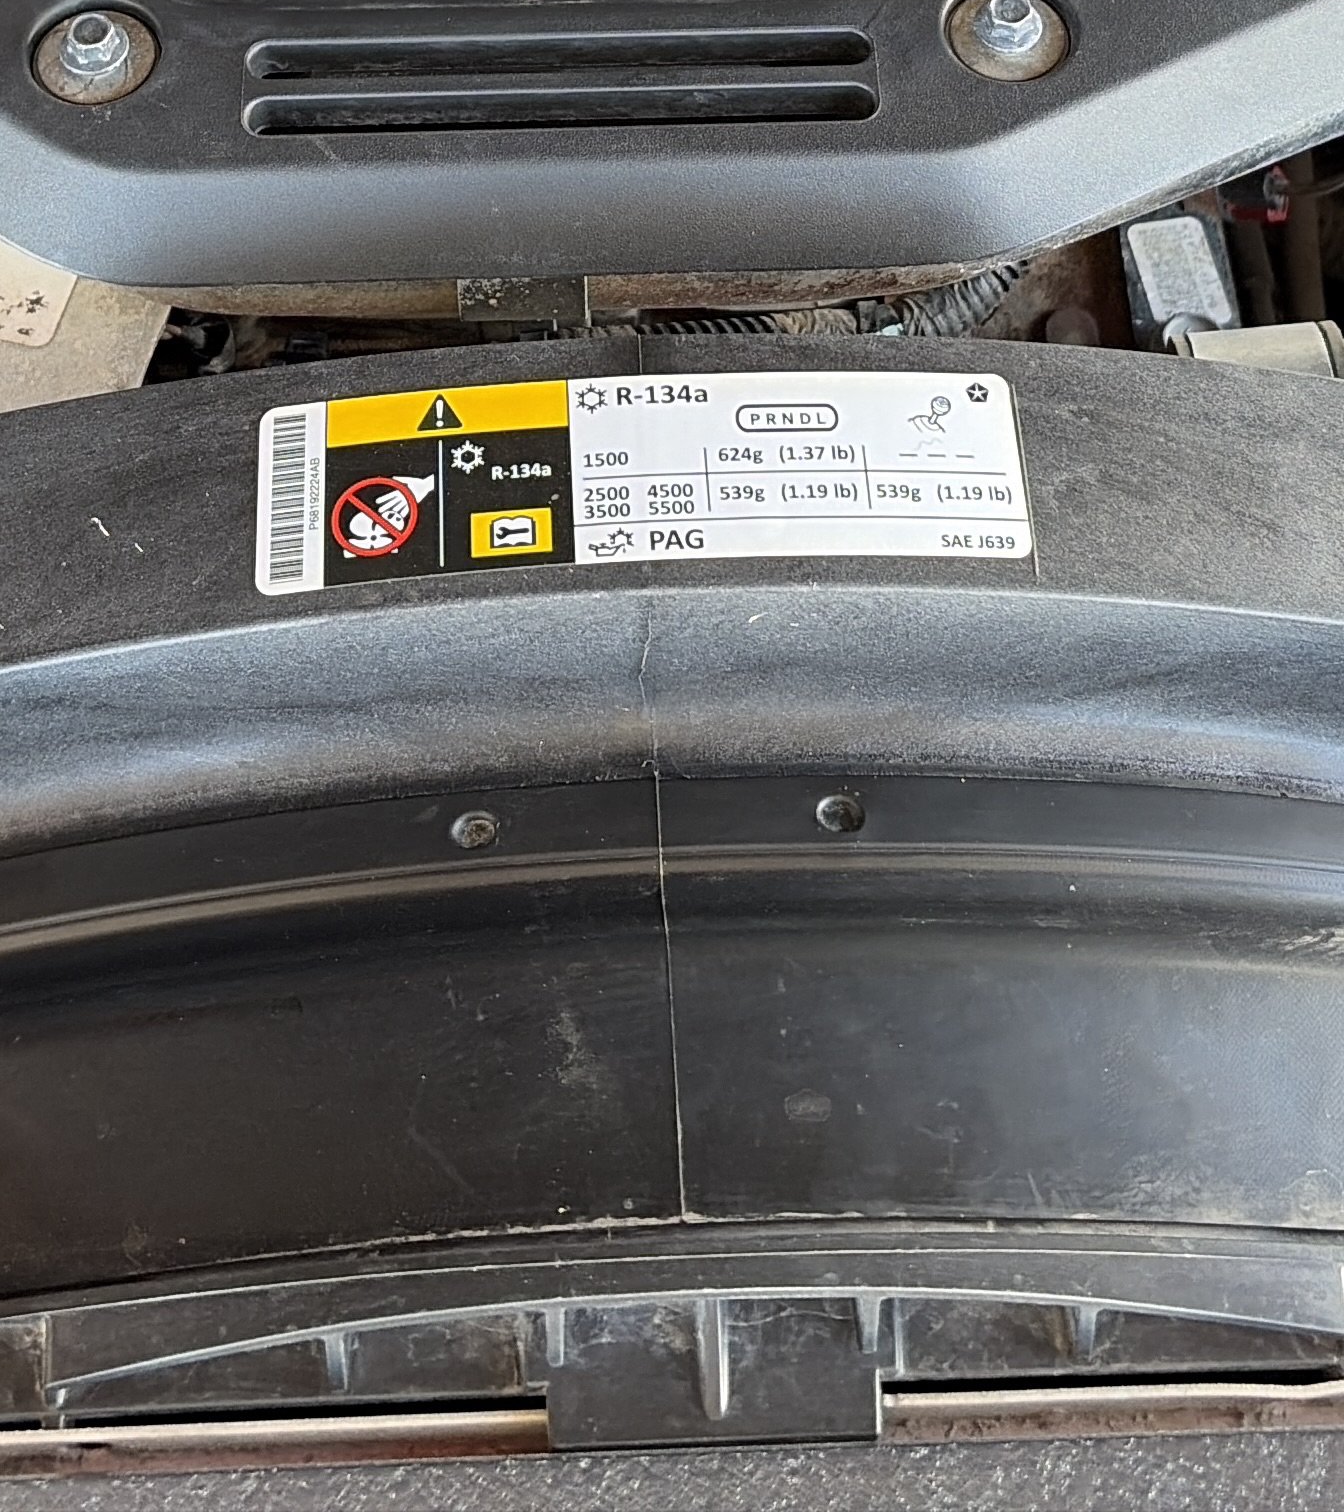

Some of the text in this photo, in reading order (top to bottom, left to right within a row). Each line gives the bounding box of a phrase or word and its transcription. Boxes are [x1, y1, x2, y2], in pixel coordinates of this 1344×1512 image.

[615, 384, 709, 406] R-134a
[583, 444, 856, 468] 1500 624g (1.37 lb)
[491, 462, 552, 481] R-134a
[583, 482, 1013, 505] 2500 4500 539g (1.19 lb) 539g (1.19 lb)
[584, 500, 695, 519] 3500 5500
[649, 529, 705, 551] PAG
[941, 534, 1016, 551] SAE J639
